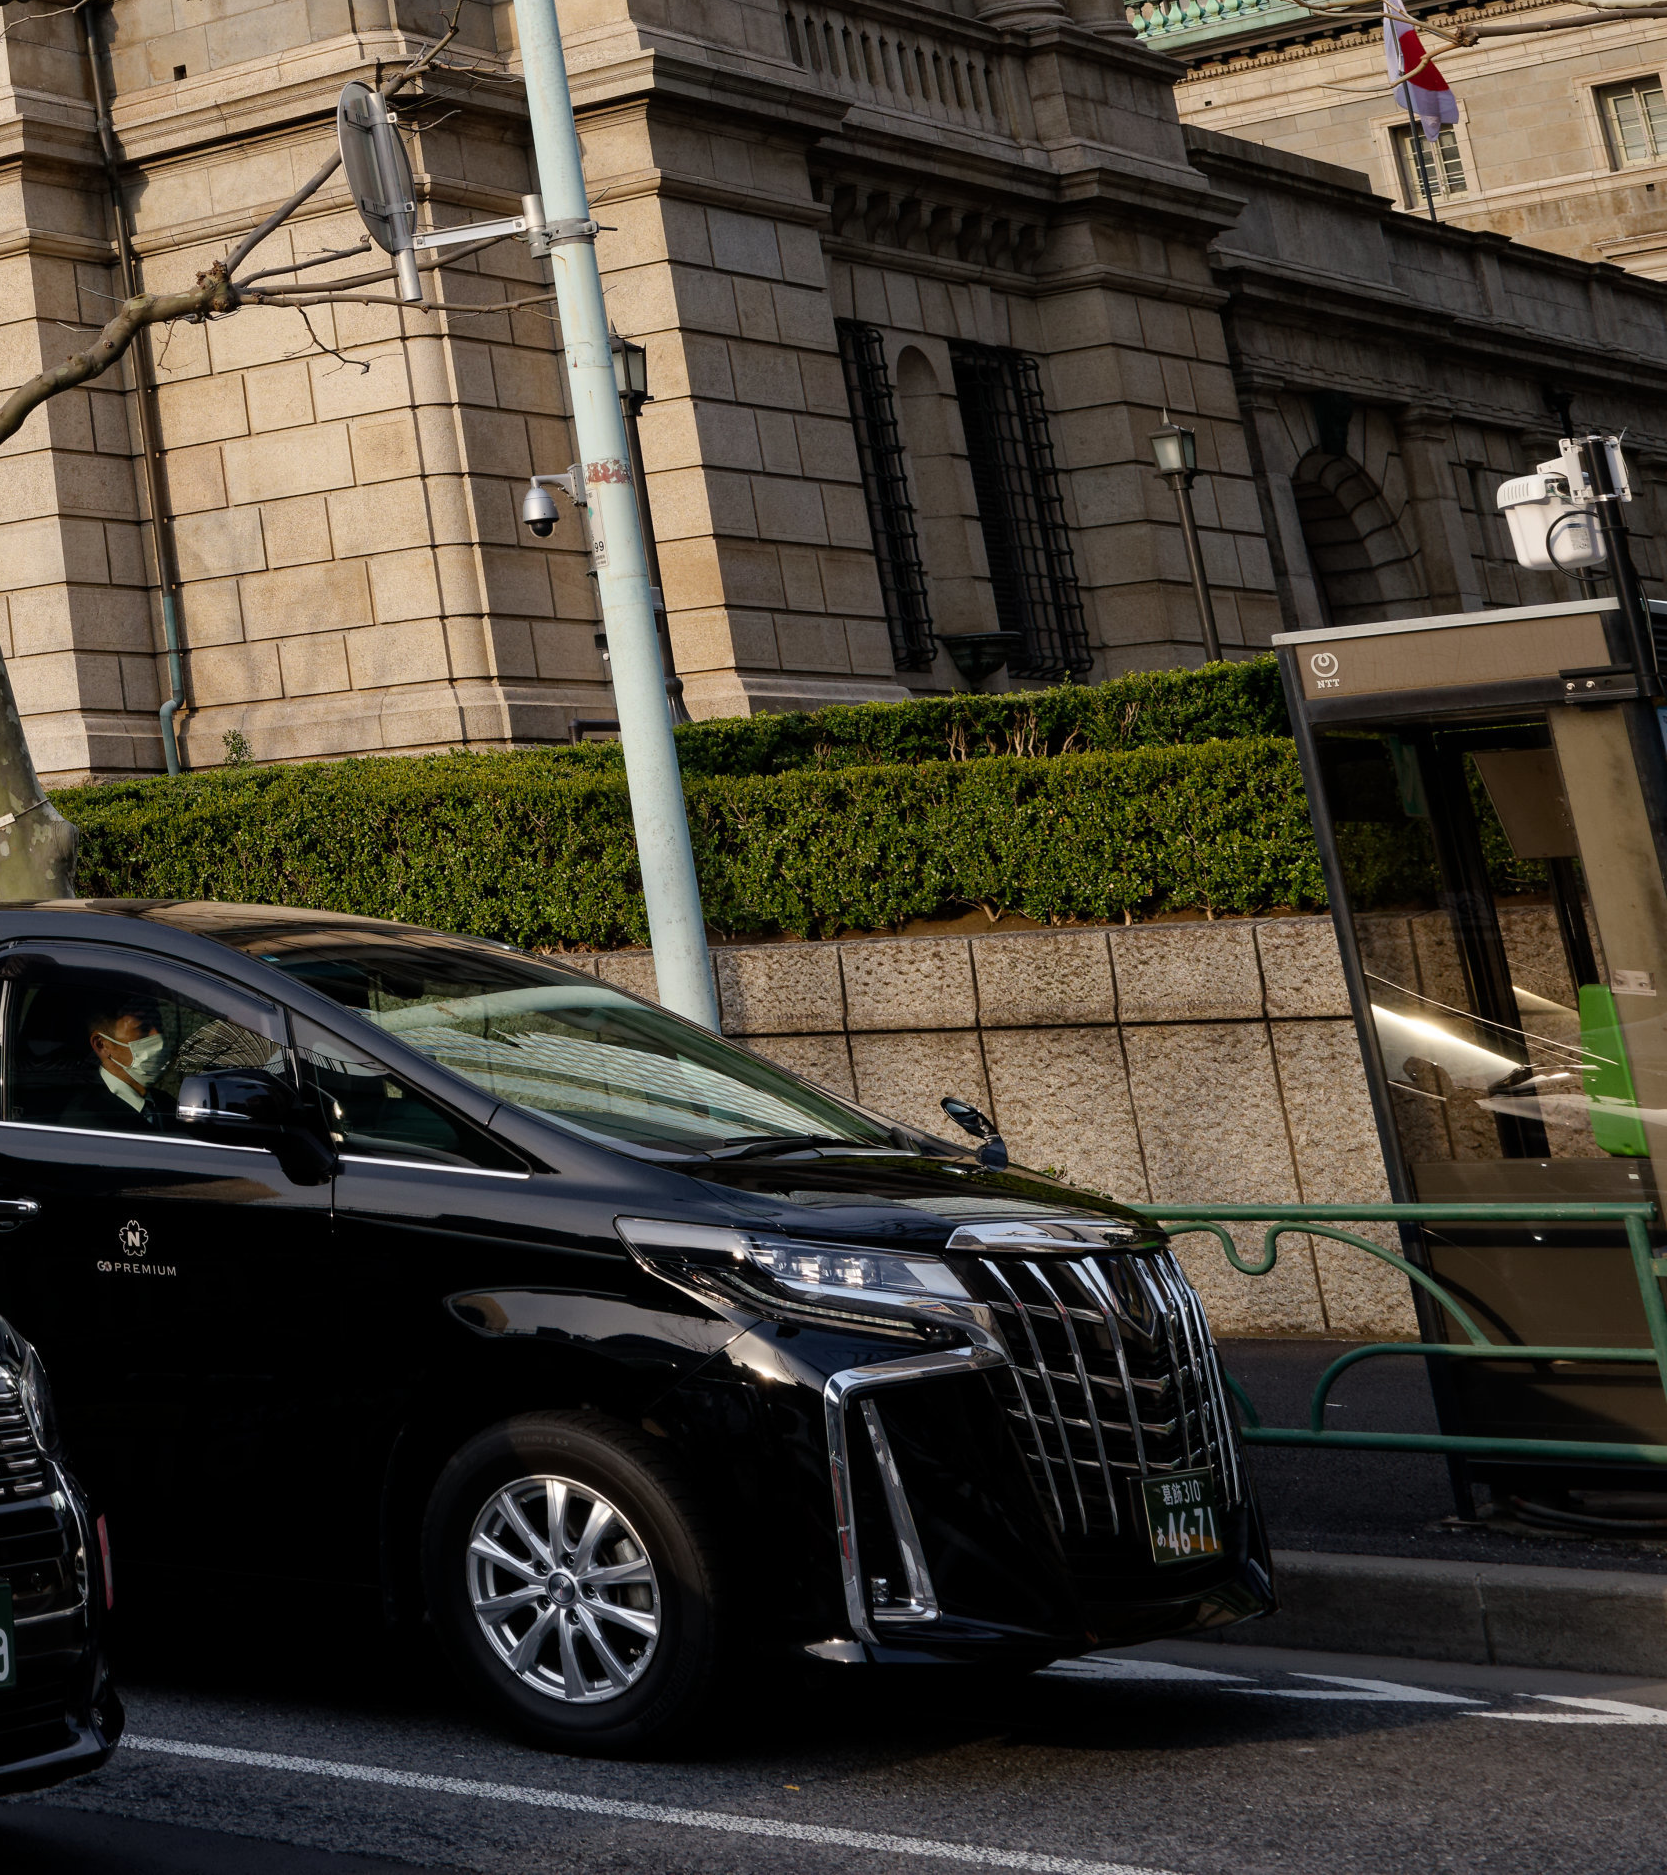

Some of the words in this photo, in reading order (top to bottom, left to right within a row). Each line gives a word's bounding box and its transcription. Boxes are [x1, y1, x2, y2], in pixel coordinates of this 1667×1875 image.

[1316, 678, 1340, 689] NTT
[127, 1230, 141, 1247] N
[114, 1262, 177, 1277] PREMIUM
[1157, 1526, 1166, 1547] あ
[1168, 1506, 1218, 1556] 46-71
